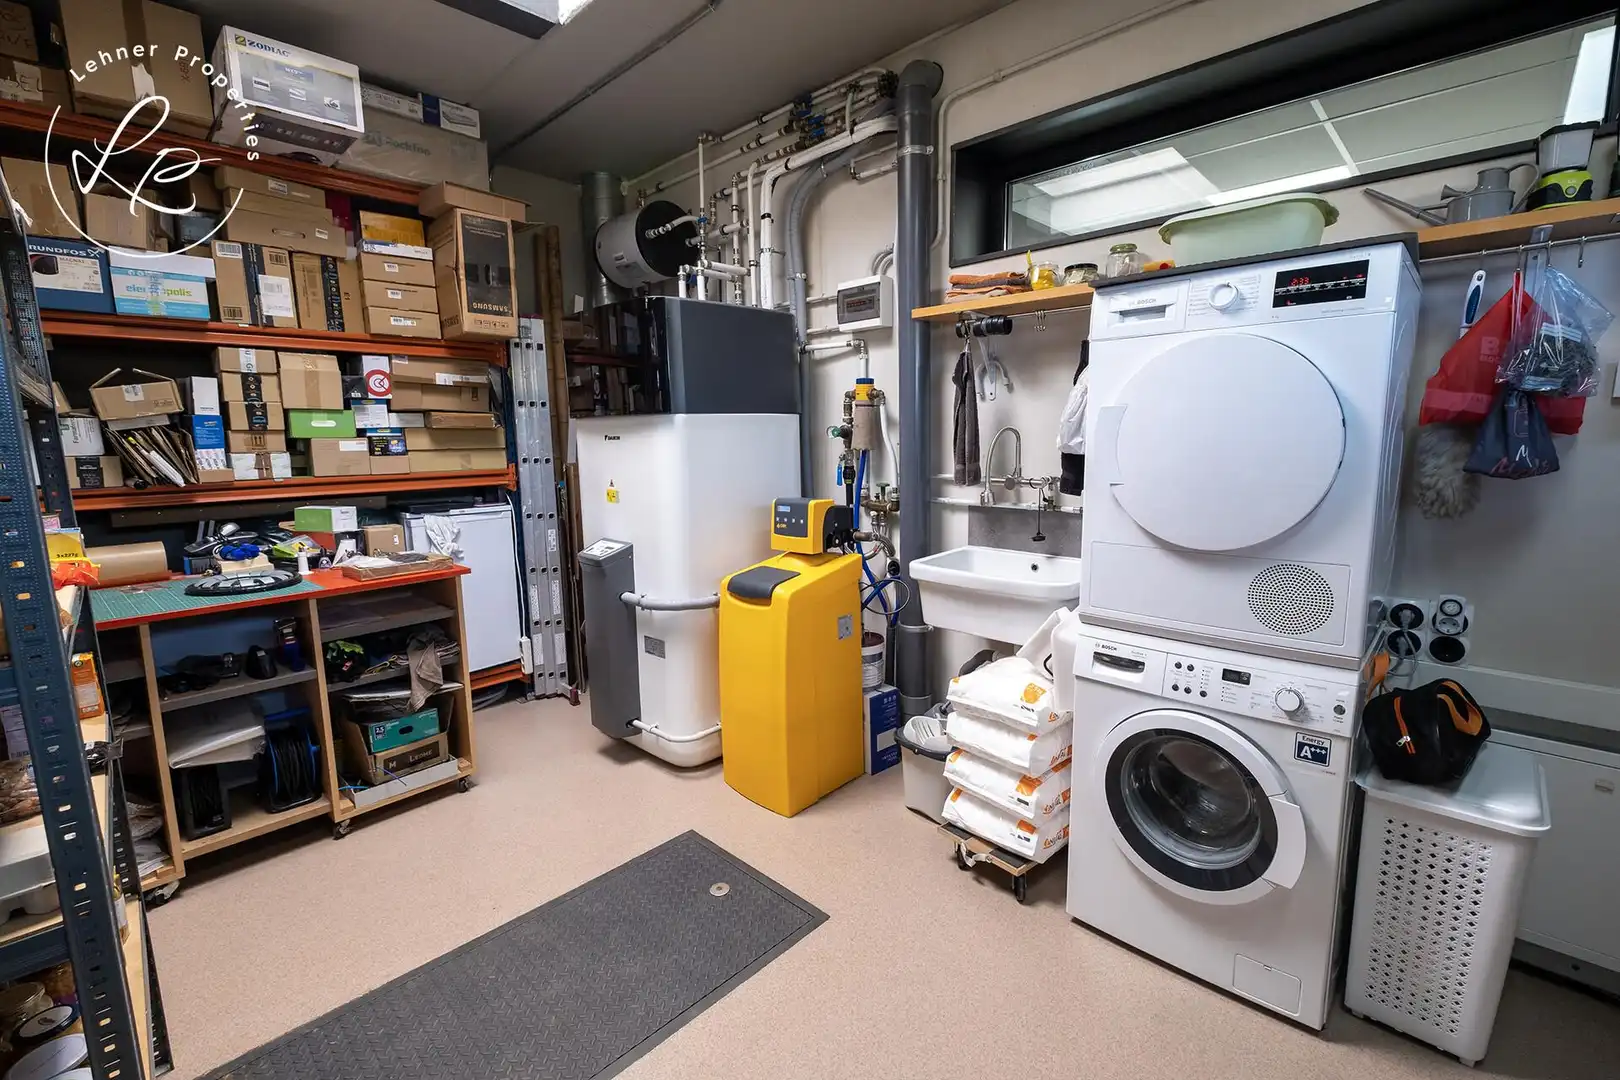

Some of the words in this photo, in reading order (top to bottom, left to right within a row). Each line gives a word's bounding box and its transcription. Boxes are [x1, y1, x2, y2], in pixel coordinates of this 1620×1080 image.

[247, 39, 290, 57] ZODIAC
[28, 244, 87, 257] RUNDFOS
[1136, 297, 1157, 305] BOSCH
[472, 302, 509, 312] SAMSUNG
[1101, 644, 1118, 652] BOSCH
[1302, 735, 1325, 746] Energy
